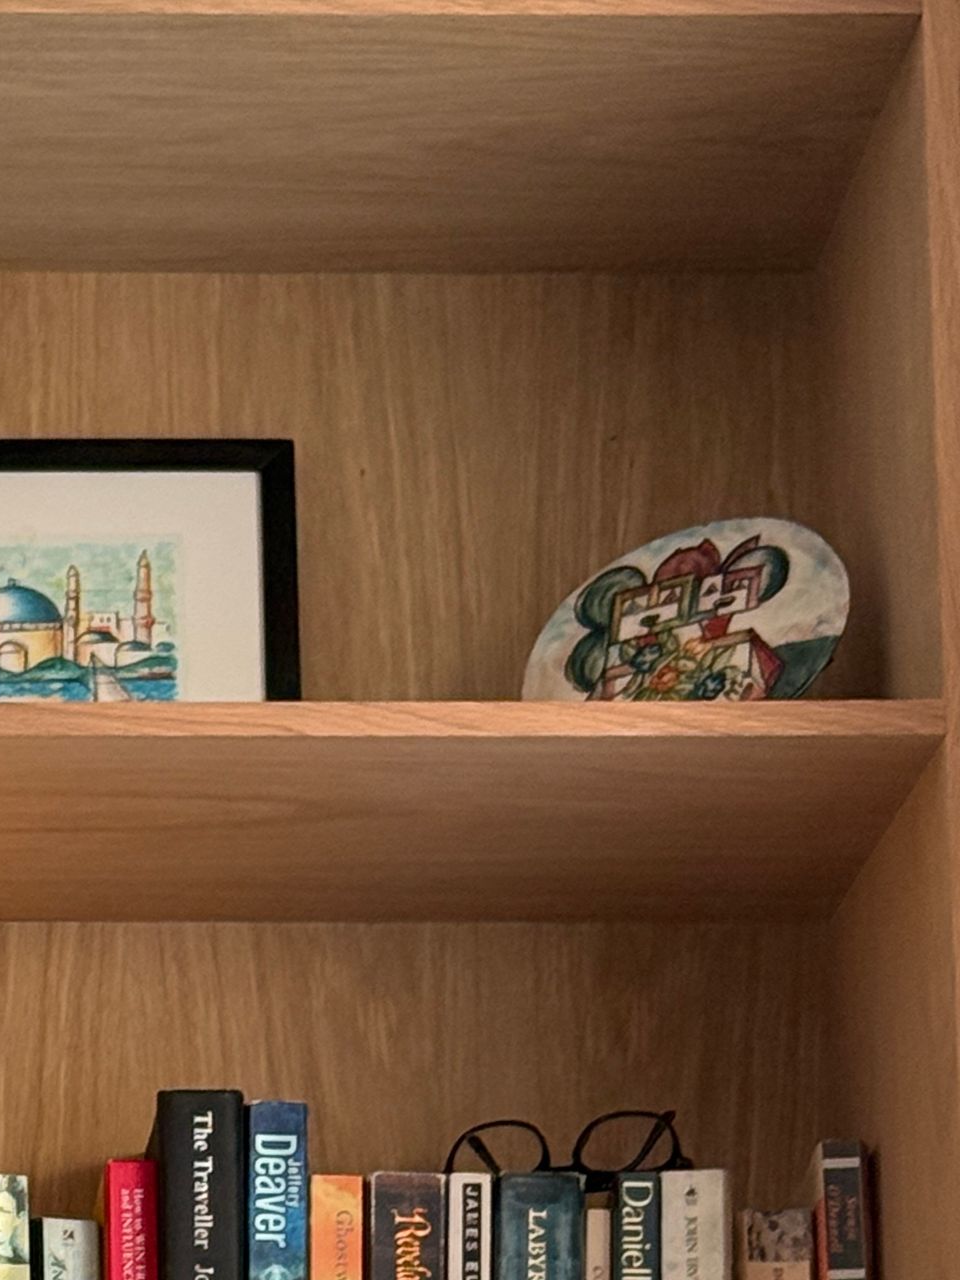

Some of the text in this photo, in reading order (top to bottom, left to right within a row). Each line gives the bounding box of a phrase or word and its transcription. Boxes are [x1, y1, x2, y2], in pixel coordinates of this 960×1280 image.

[193, 1111, 214, 1152] The
[121, 1188, 133, 1209] and
[134, 1188, 144, 1214] How
[192, 1156, 214, 1250] Traveller
[254, 1133, 297, 1248] Deaver
[285, 1158, 301, 1209] Jeffery
[134, 1218, 142, 1230] to
[465, 1185, 479, 1251] JAMES
[685, 1216, 698, 1253] JOHN
[135, 1233, 145, 1261] WIN
